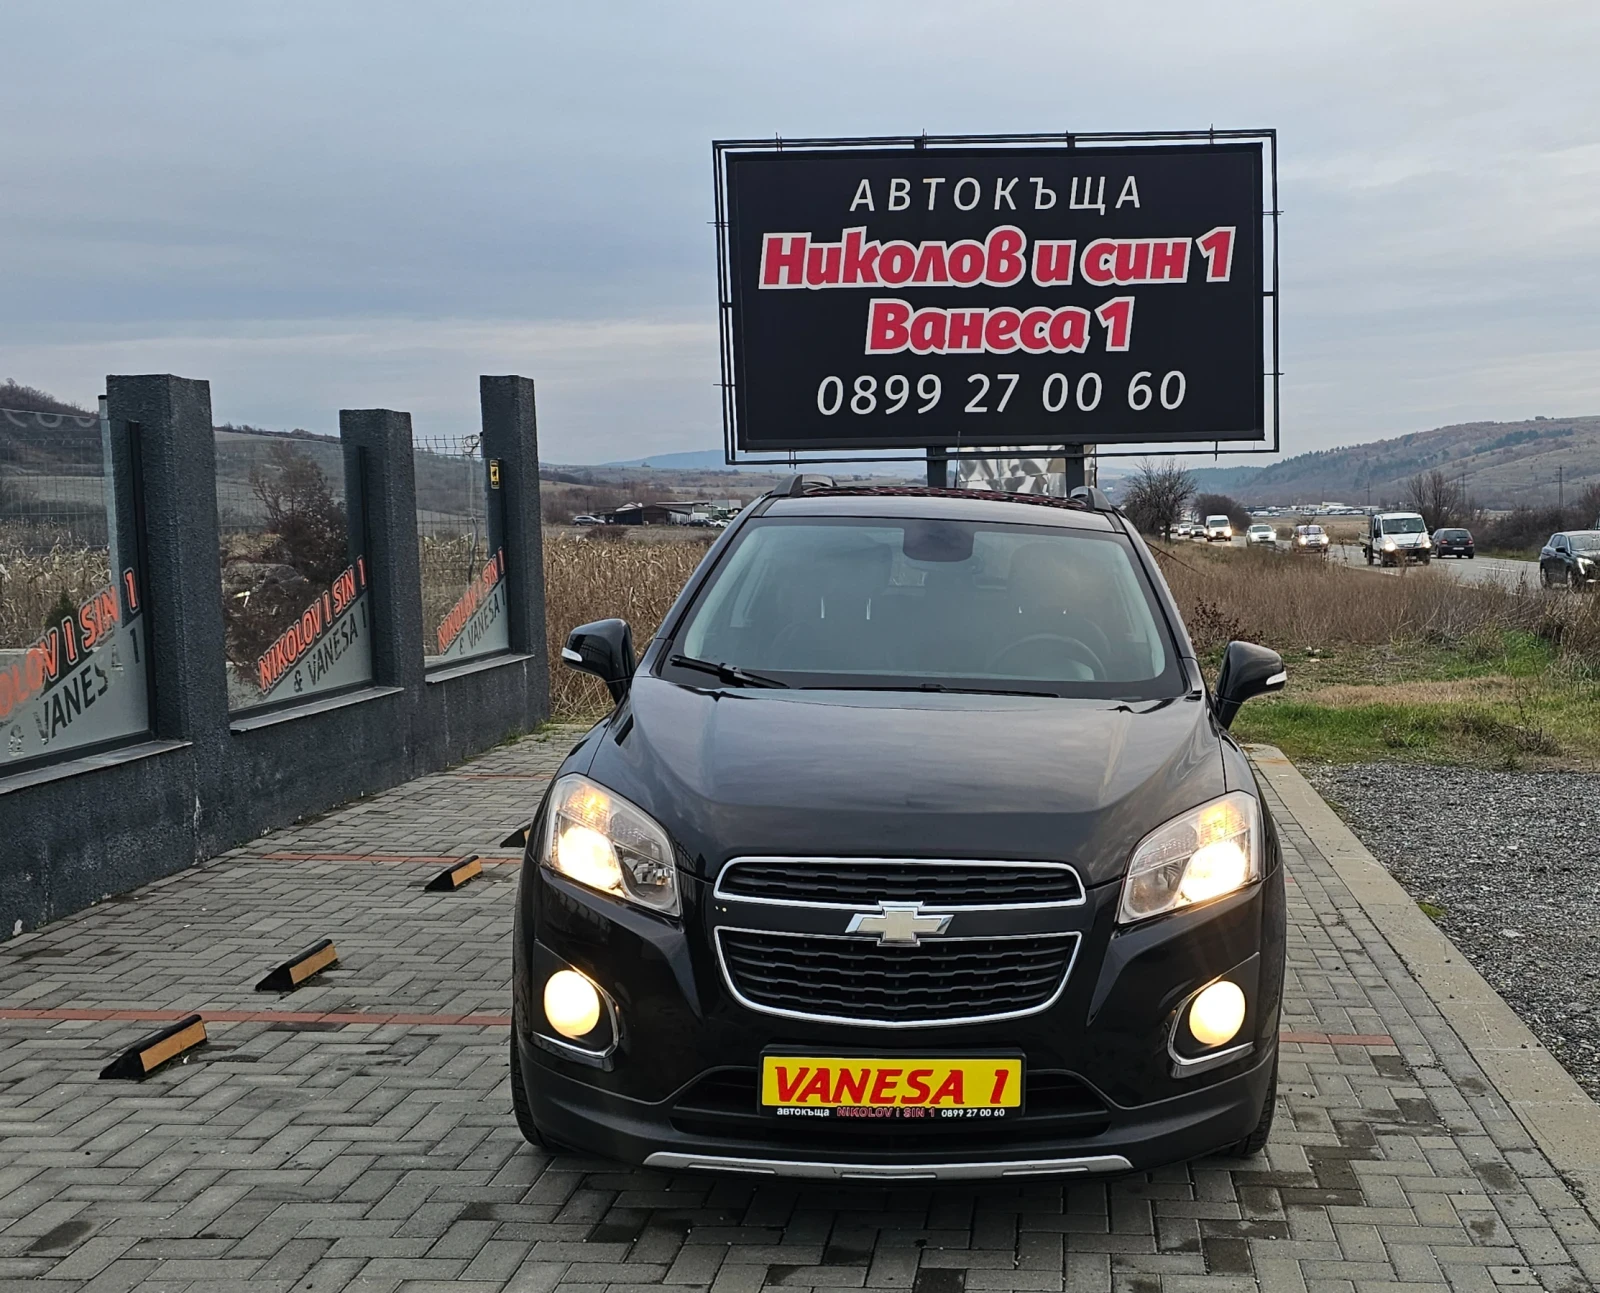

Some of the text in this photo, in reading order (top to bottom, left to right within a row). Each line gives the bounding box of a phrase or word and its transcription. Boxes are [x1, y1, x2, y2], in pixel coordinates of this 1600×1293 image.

[850, 175, 1142, 216] АВТОКЪЩА
[758, 224, 1236, 290] Николов и син 1
[865, 296, 1135, 355] Ванеса 1
[817, 370, 1187, 415] 0899 27 00 60
[62, 616, 79, 665] I
[79, 585, 121, 651] SIN
[123, 567, 140, 614] 1
[258, 555, 366, 694] NIKOLOV I SIN 1
[467, 593, 501, 650] VANESA
[130, 627, 140, 664] 1
[294, 601, 367, 693] & VANESA 1
[774, 1066, 1009, 1105] VANESA 1
[777, 1107, 830, 1118] автокъща
[837, 1106, 893, 1118] NIKOLOV
[903, 1106, 925, 1118] SIN
[929, 1107, 935, 1118] 1
[941, 1109, 964, 1118] 0899
[966, 1109, 978, 1117] 27
[980, 1108, 991, 1117] 00
[994, 1108, 1006, 1117] 60
